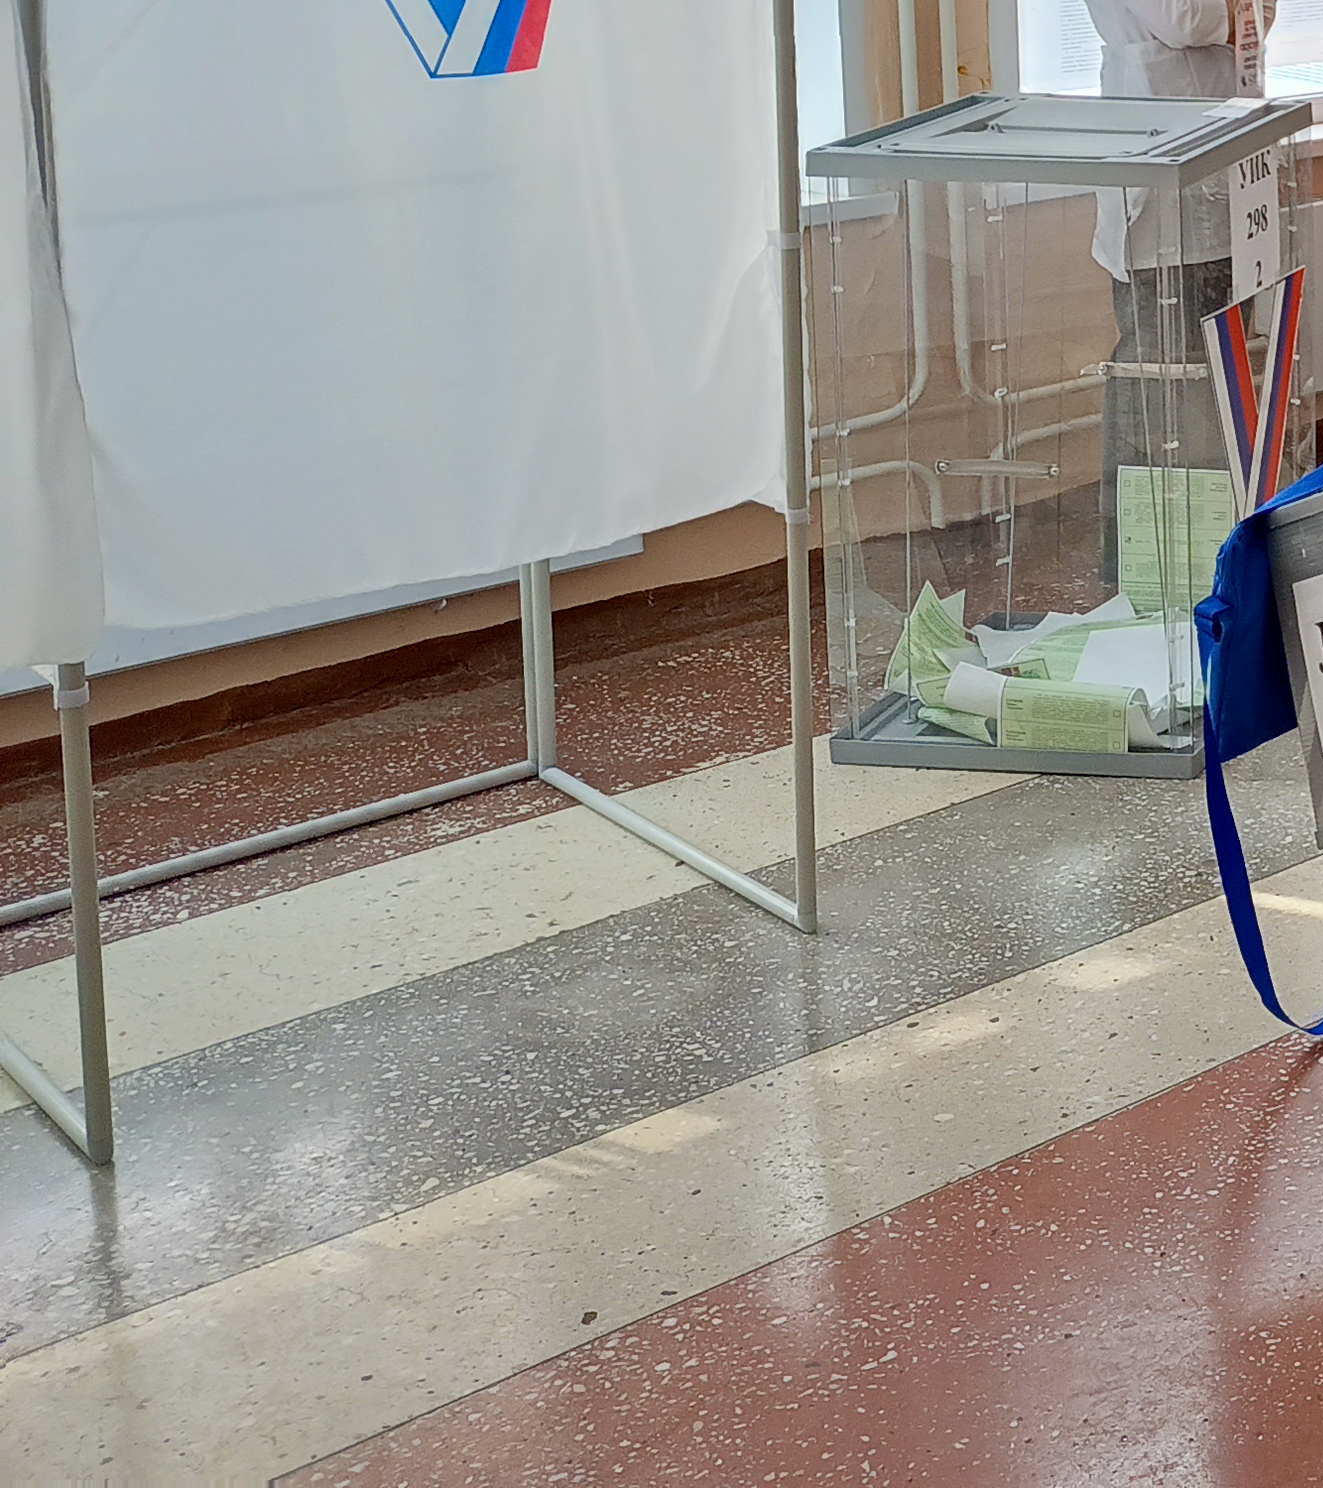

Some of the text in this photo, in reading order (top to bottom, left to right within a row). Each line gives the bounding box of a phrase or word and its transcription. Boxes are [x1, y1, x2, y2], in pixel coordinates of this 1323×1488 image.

[1239, 150, 1271, 190] УИК
[1246, 204, 1268, 240] 298
[1255, 260, 1263, 288] 2
